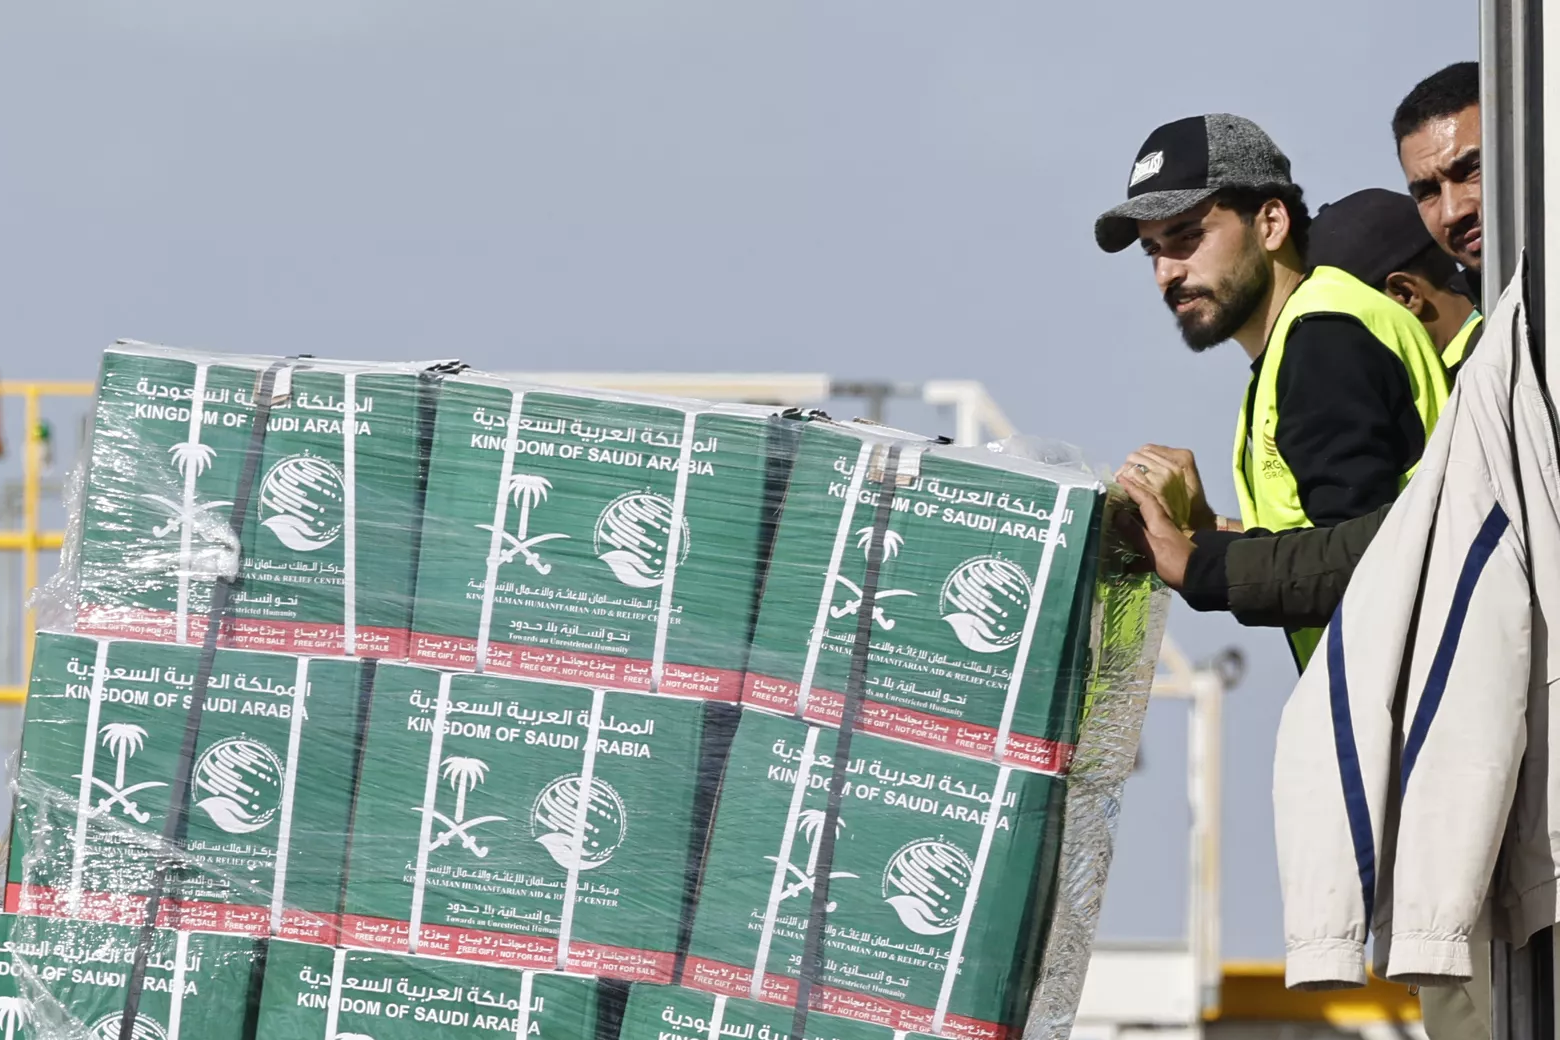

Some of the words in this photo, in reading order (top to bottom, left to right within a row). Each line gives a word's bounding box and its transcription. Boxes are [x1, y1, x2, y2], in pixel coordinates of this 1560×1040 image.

[134, 403, 218, 425] KINGDM
[223, 412, 248, 428] OF
[303, 418, 372, 436] ARAIA
[473, 408, 565, 434] السعدية
[570, 419, 636, 443] العربية
[640, 427, 718, 453] الملكة
[559, 444, 583, 459] OF
[587, 447, 642, 467] SAUDI
[927, 477, 993, 507] العربية
[827, 482, 910, 512] KIGDM
[914, 502, 938, 517] OF
[942, 507, 996, 531] SAUDI
[999, 521, 1066, 547] ARABA
[997, 493, 1073, 524] الملكة
[164, 666, 229, 690] العبية
[234, 673, 310, 698] امملكة
[596, 672, 614, 680] SALE
[153, 692, 177, 707] OF
[506, 701, 572, 725] العربية
[577, 709, 653, 735] المملة
[495, 727, 520, 741] OF
[524, 730, 578, 749] SAUDI
[582, 737, 650, 758] RABIA
[869, 760, 935, 789] العربية
[938, 775, 1016, 807] الملكة
[855, 784, 880, 800] OF
[883, 790, 938, 814] SAUDI
[941, 804, 1008, 830] ARABA
[42, 966, 66, 980] OF
[70, 969, 125, 987] SAUDI
[299, 966, 392, 993] السعدية
[396, 978, 462, 1002] العربية
[467, 986, 543, 1012] الملكة
[385, 1003, 409, 1018] OF
[414, 1006, 468, 1026] SAUDI
[472, 1014, 540, 1035] ARABA
[662, 1006, 754, 1039] السودية
